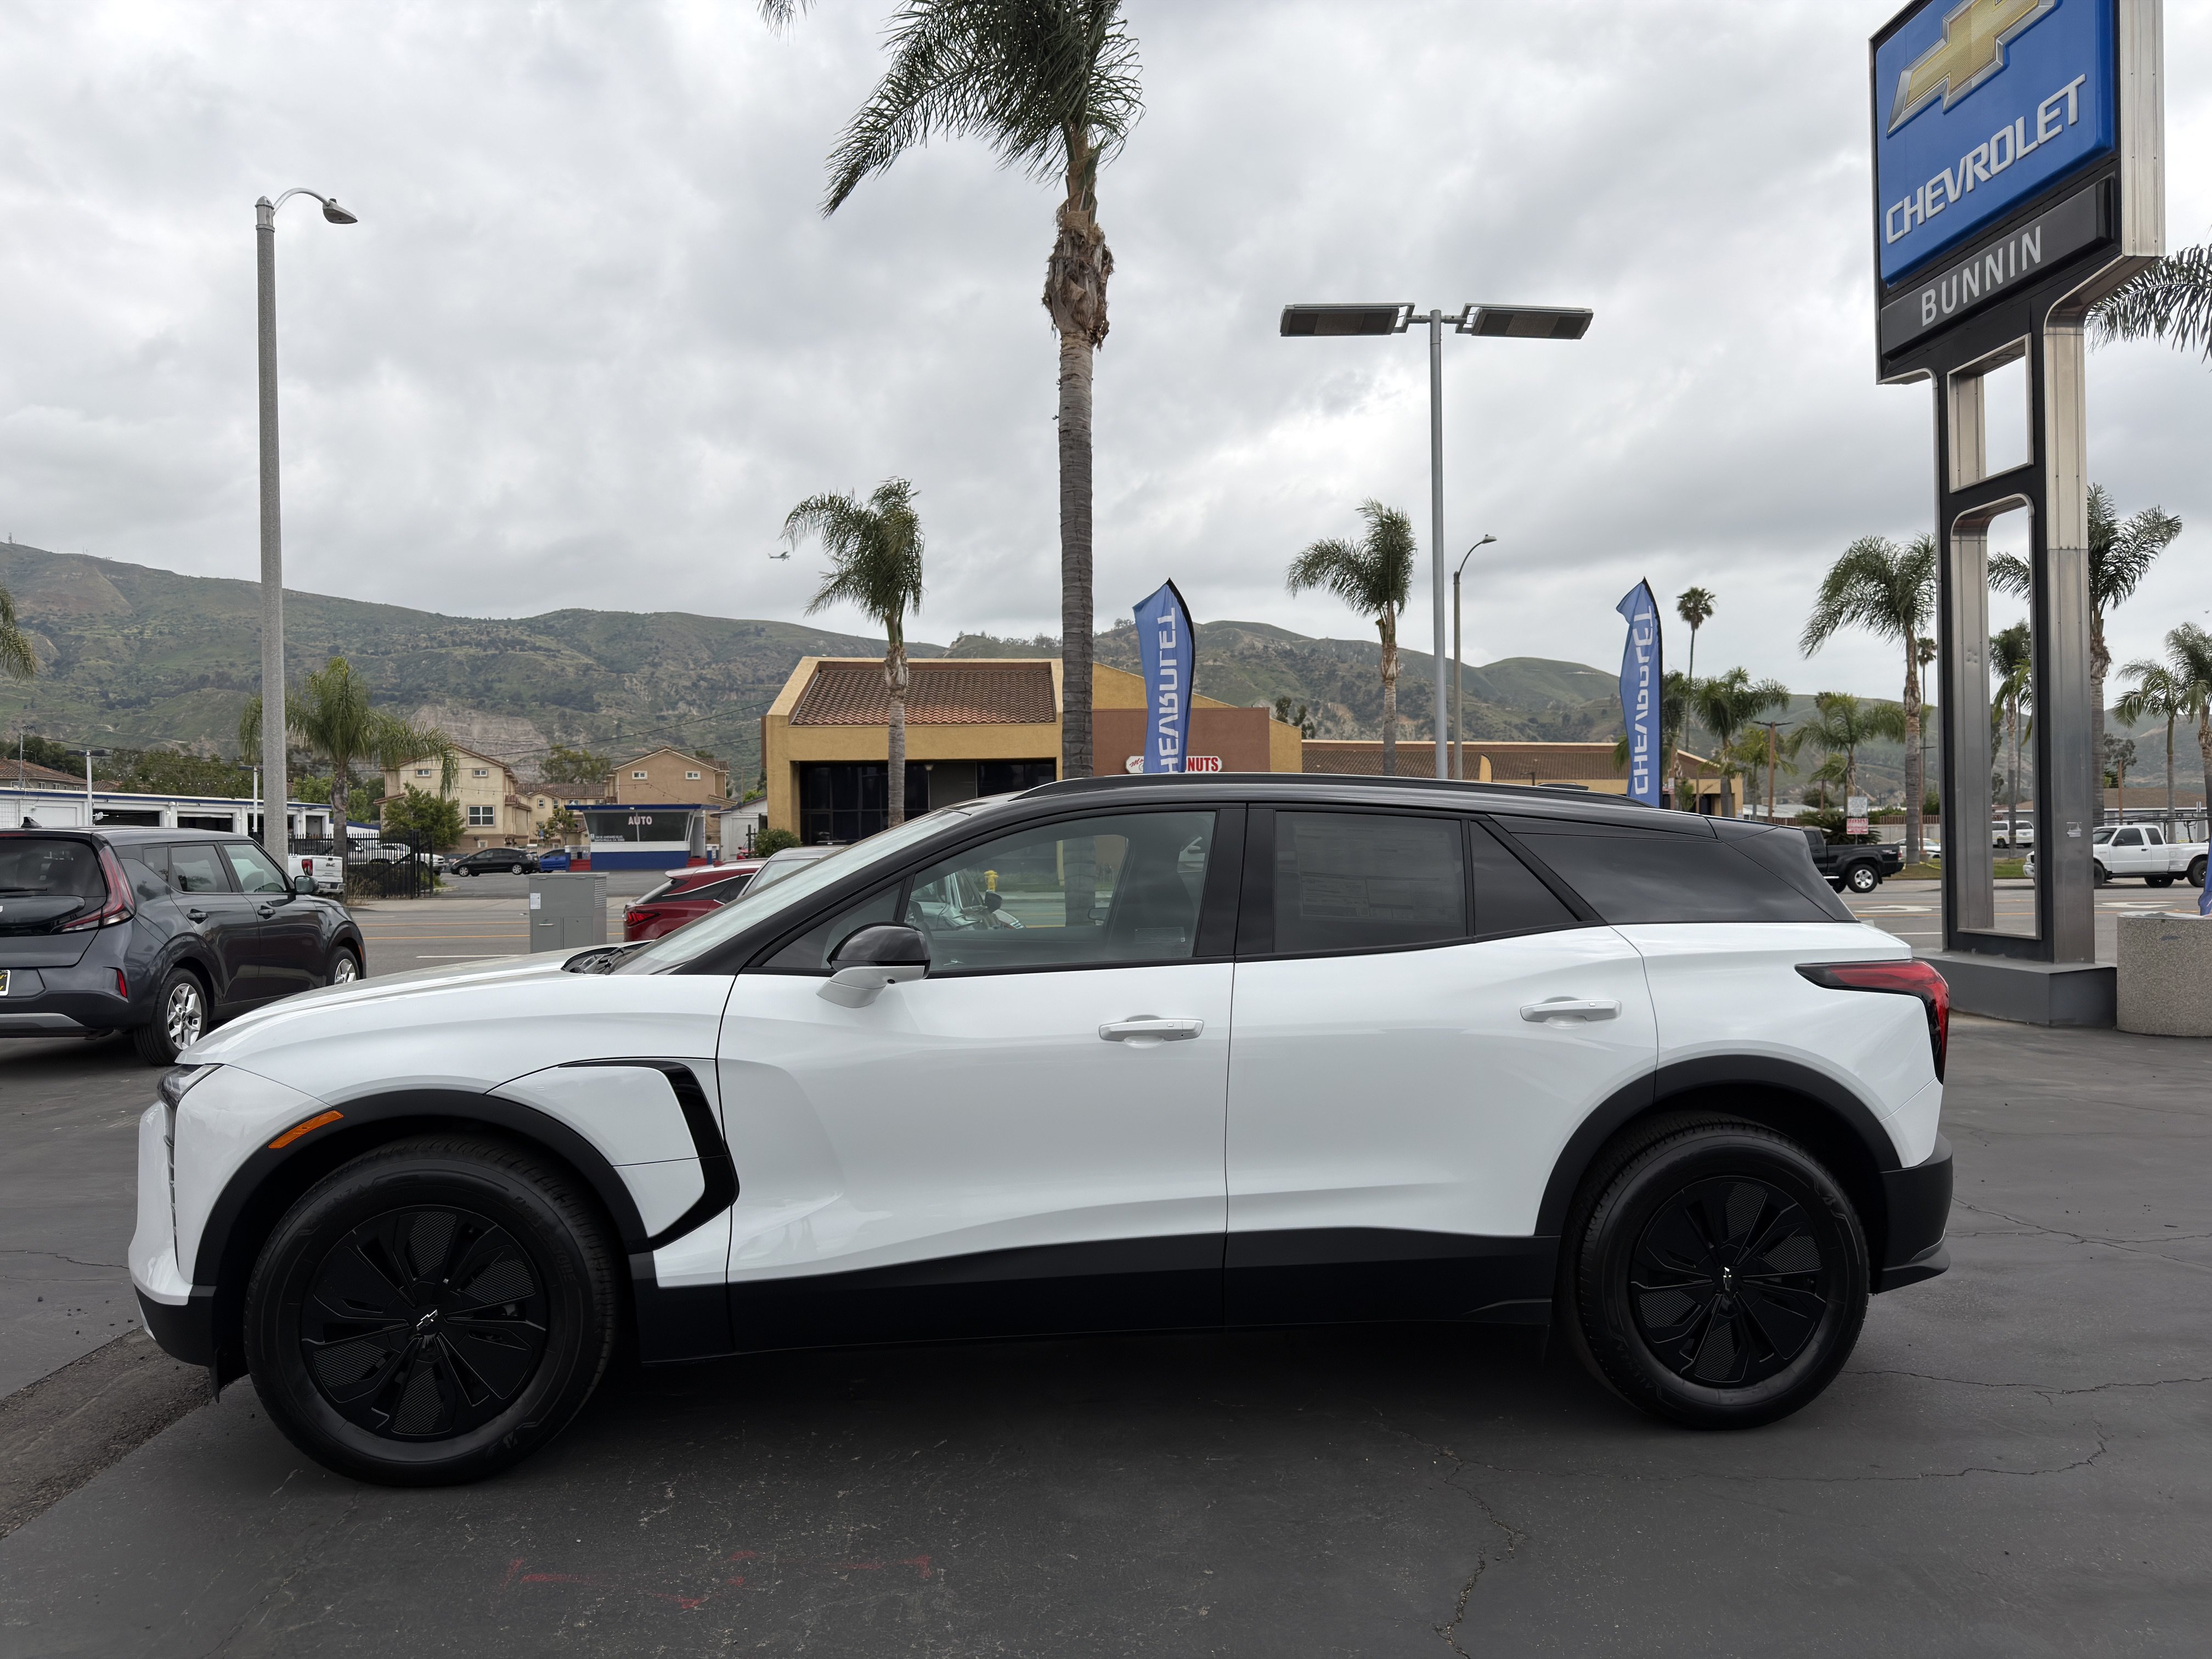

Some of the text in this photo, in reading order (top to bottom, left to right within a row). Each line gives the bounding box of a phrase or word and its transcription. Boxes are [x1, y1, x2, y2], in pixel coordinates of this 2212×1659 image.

[1886, 73, 2087, 244] CHEVROLET
[1921, 225, 2042, 328] BUNNIN
[1185, 757, 1218, 772] NUTS
[628, 816, 652, 825] AUTO
